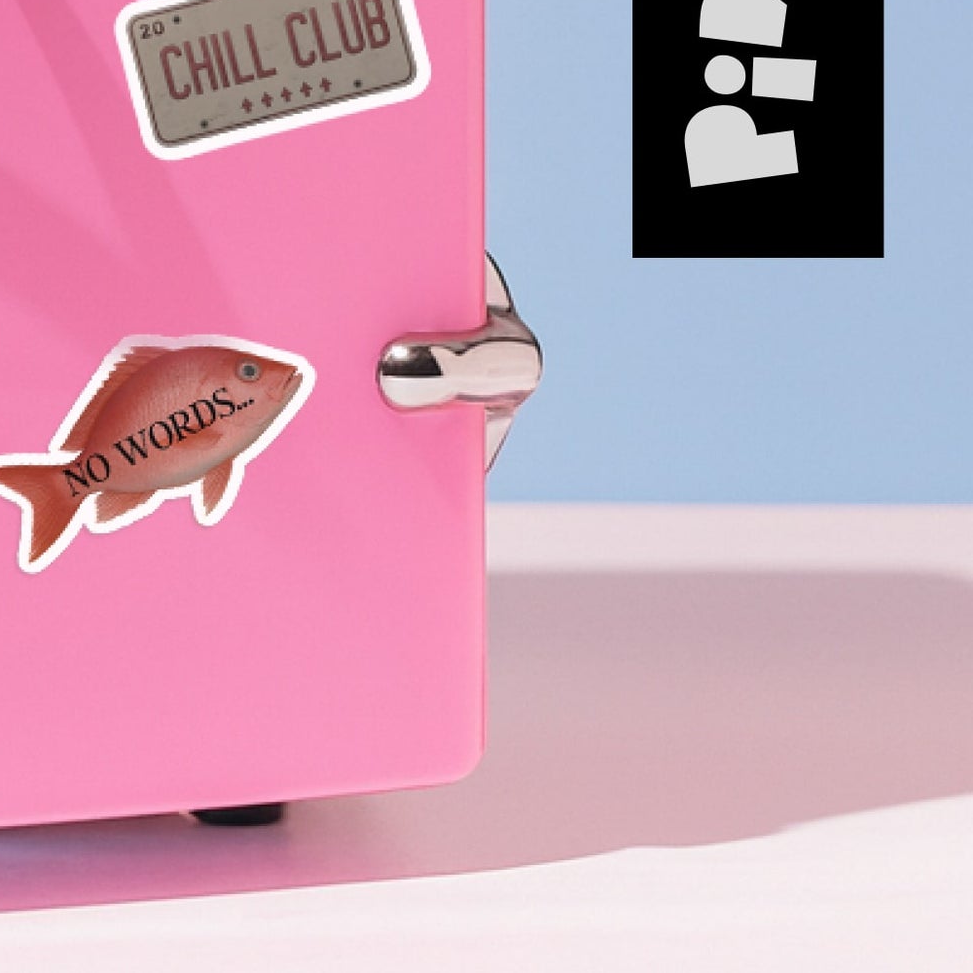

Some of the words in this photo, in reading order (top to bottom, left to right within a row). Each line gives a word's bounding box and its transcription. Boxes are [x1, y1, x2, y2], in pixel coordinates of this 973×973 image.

[139, 21, 165, 39] 20
[159, 23, 277, 100] CHILL
[62, 452, 112, 497] NO
[113, 387, 255, 466] WORDS...
